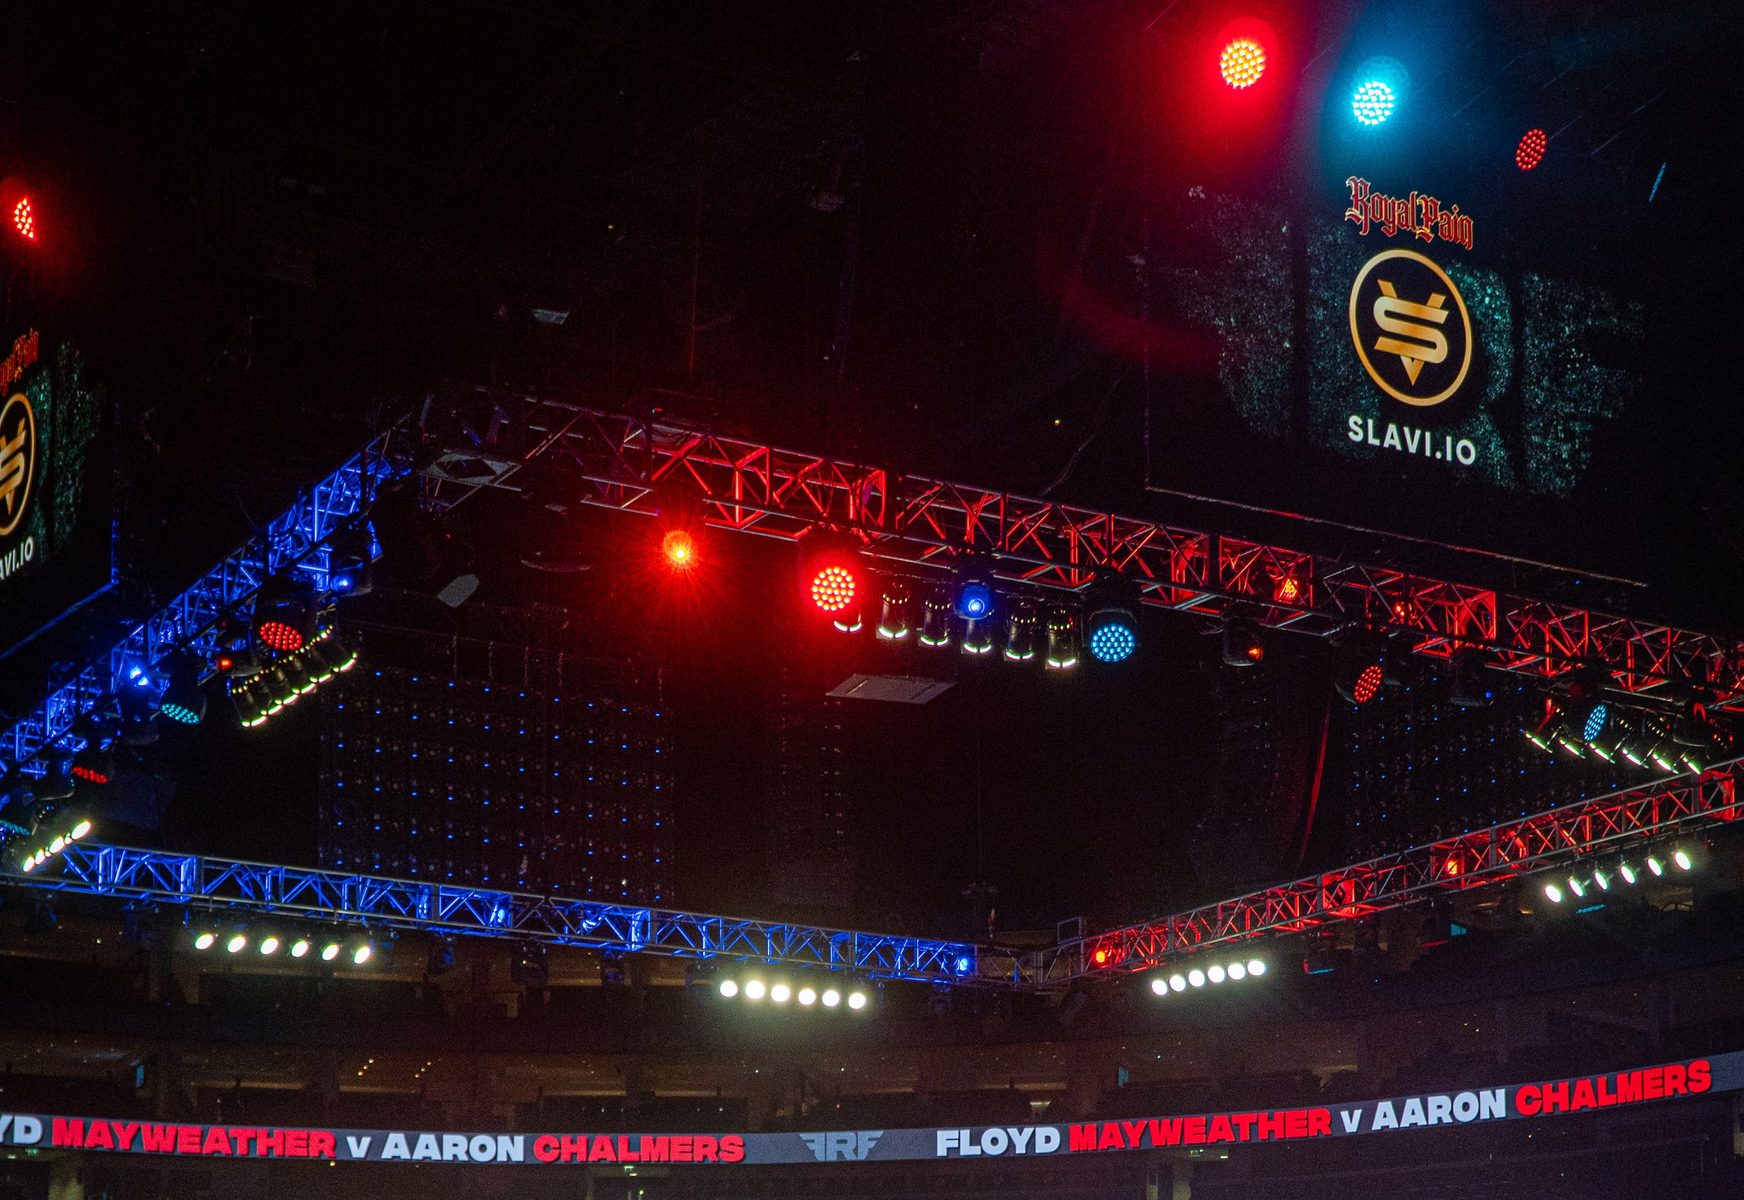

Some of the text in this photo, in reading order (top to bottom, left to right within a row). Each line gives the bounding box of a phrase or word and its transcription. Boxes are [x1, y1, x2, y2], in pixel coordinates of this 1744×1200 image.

[1345, 176, 1473, 250] Royal Pain
[1348, 415, 1476, 466] SLAVI.IO
[937, 1127, 1061, 1157] FLOYD
[1069, 1108, 1332, 1151] MAYWEATHER
[1371, 1088, 1507, 1131] AARON
[1515, 1060, 1712, 1117] CHALMERS
[51, 1117, 336, 1158] MAYWEATHER
[381, 1133, 525, 1162] AARON
[533, 1135, 745, 1163] CHALMERS
